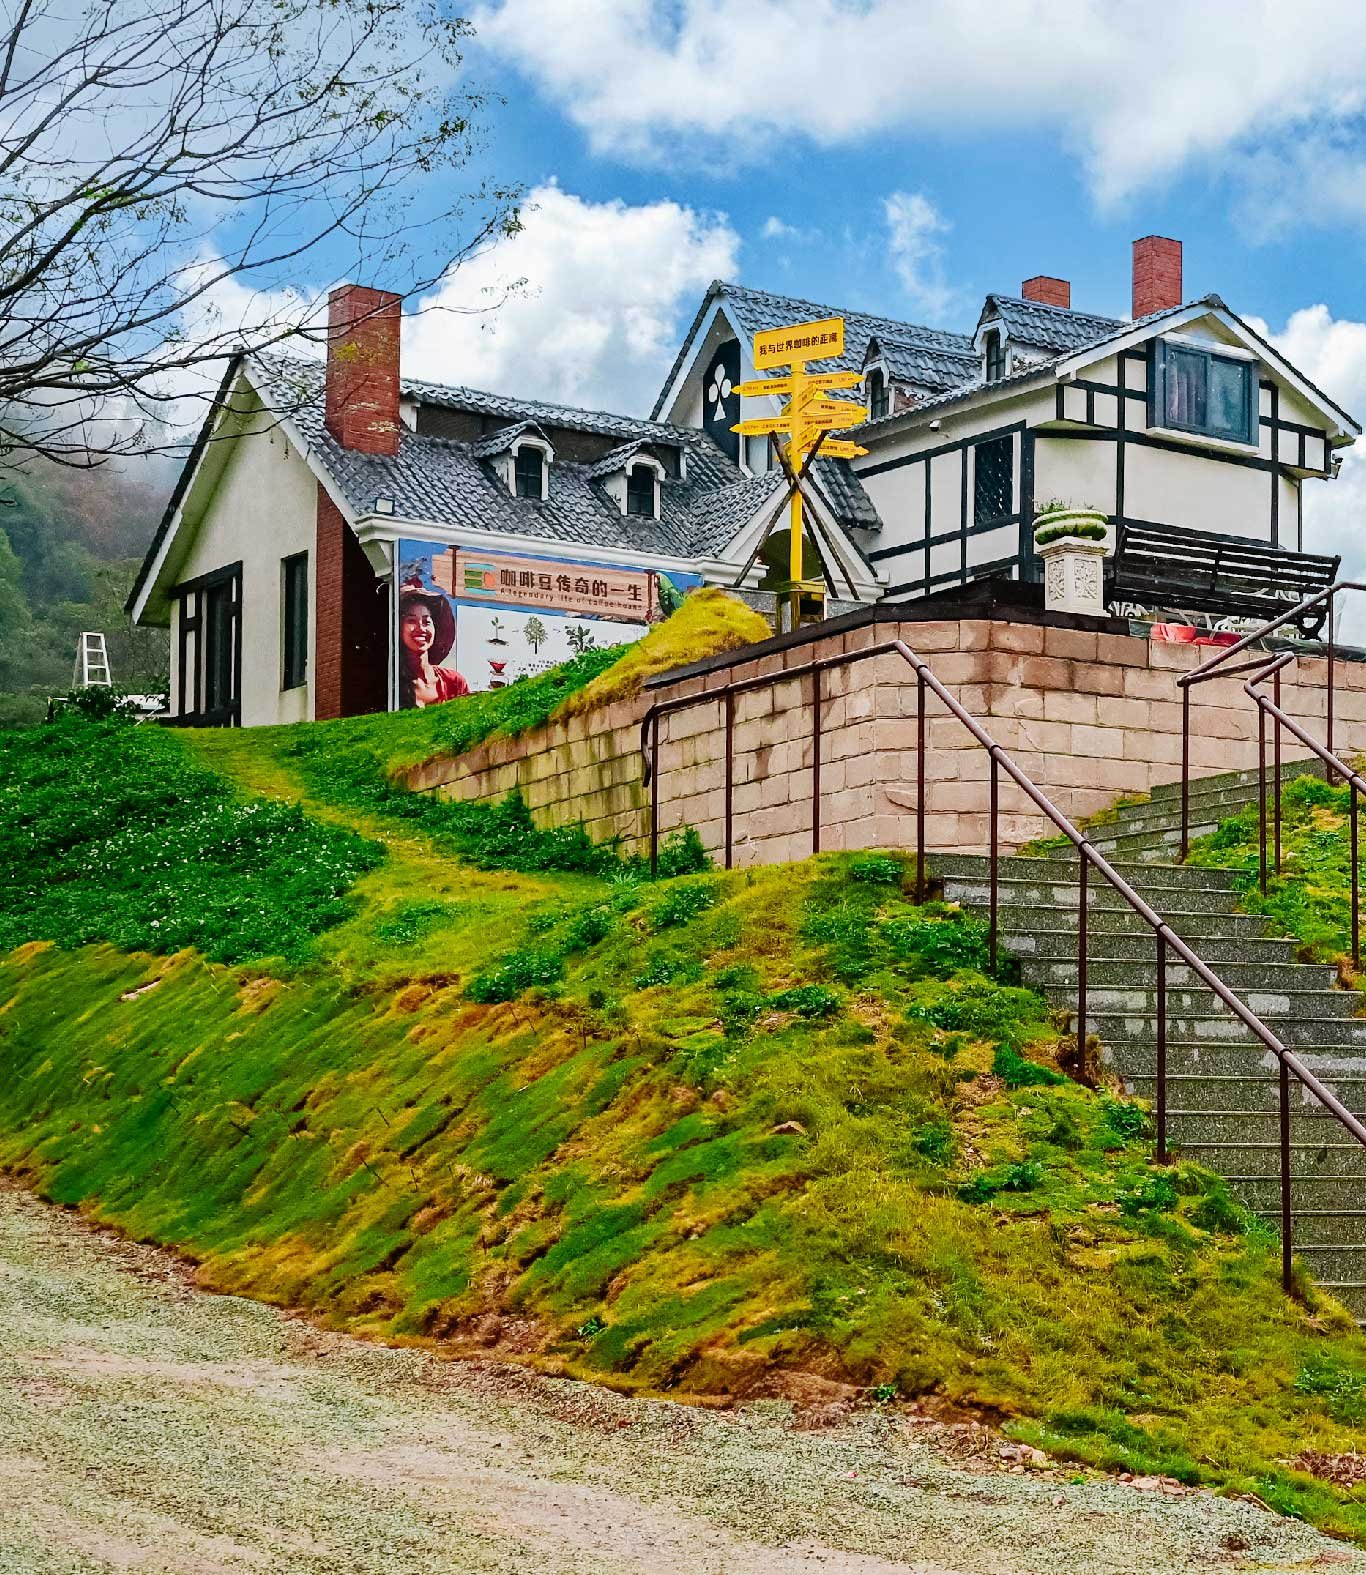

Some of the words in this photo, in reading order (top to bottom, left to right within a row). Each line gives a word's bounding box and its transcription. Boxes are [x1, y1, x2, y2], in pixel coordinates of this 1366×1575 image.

[759, 332, 838, 356] 我与世界咖啡的距离
[500, 569, 643, 602] 咖啡豆传奇的一生
[508, 588, 555, 602] legendary
